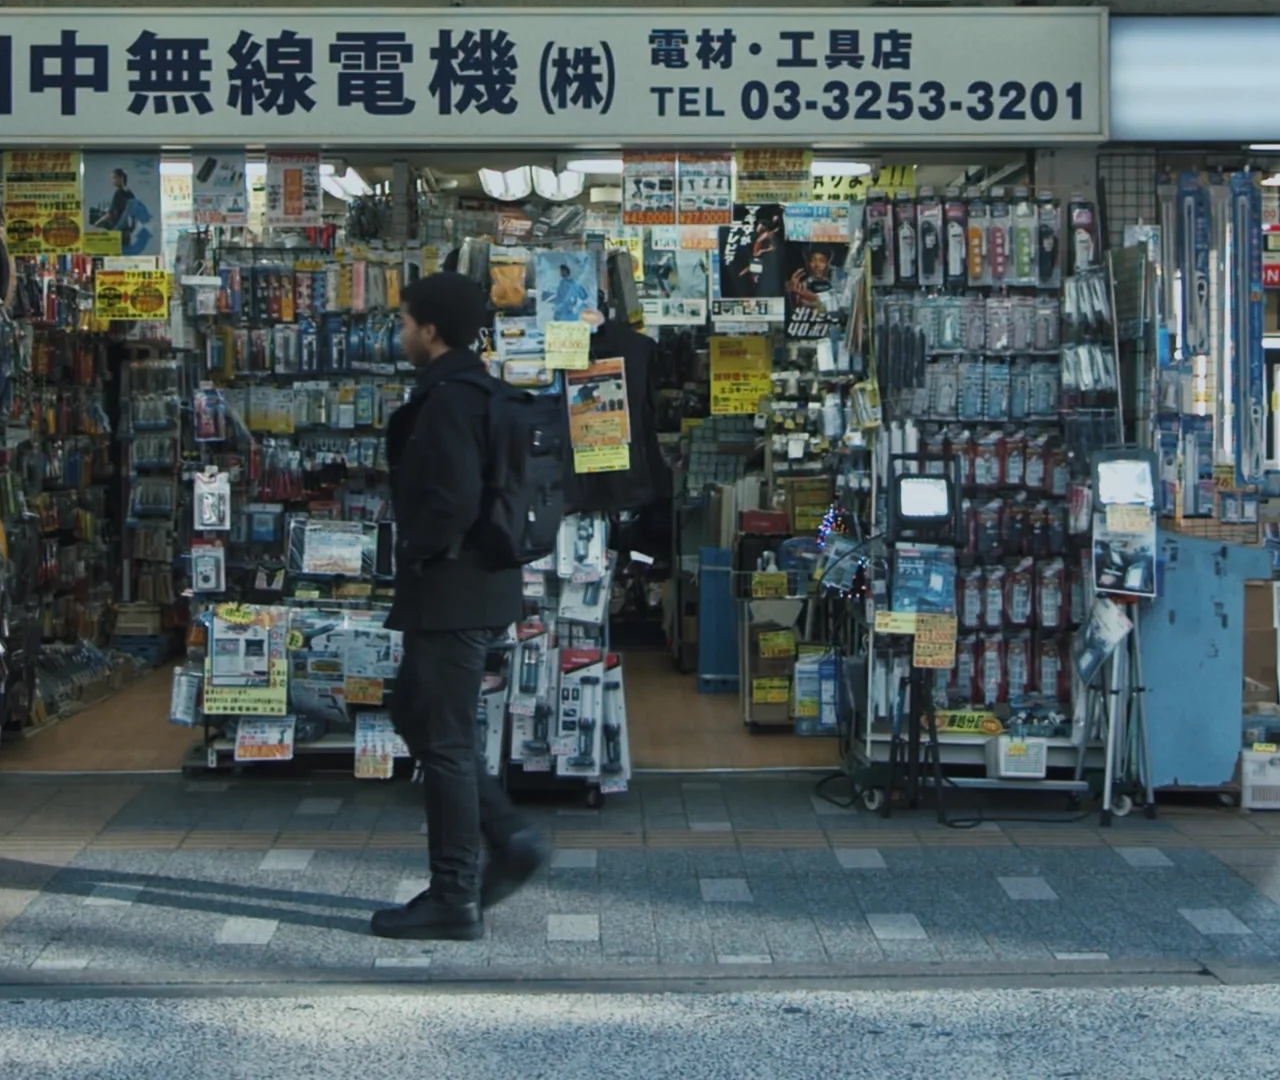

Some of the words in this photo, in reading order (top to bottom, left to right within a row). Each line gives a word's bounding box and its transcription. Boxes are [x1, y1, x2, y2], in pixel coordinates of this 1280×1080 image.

[649, 29, 914, 71] 電材・工具店
[651, 87, 727, 118] TEL
[741, 81, 1084, 123] 03-3253-3201
[1261, 269, 1280, 283] N
